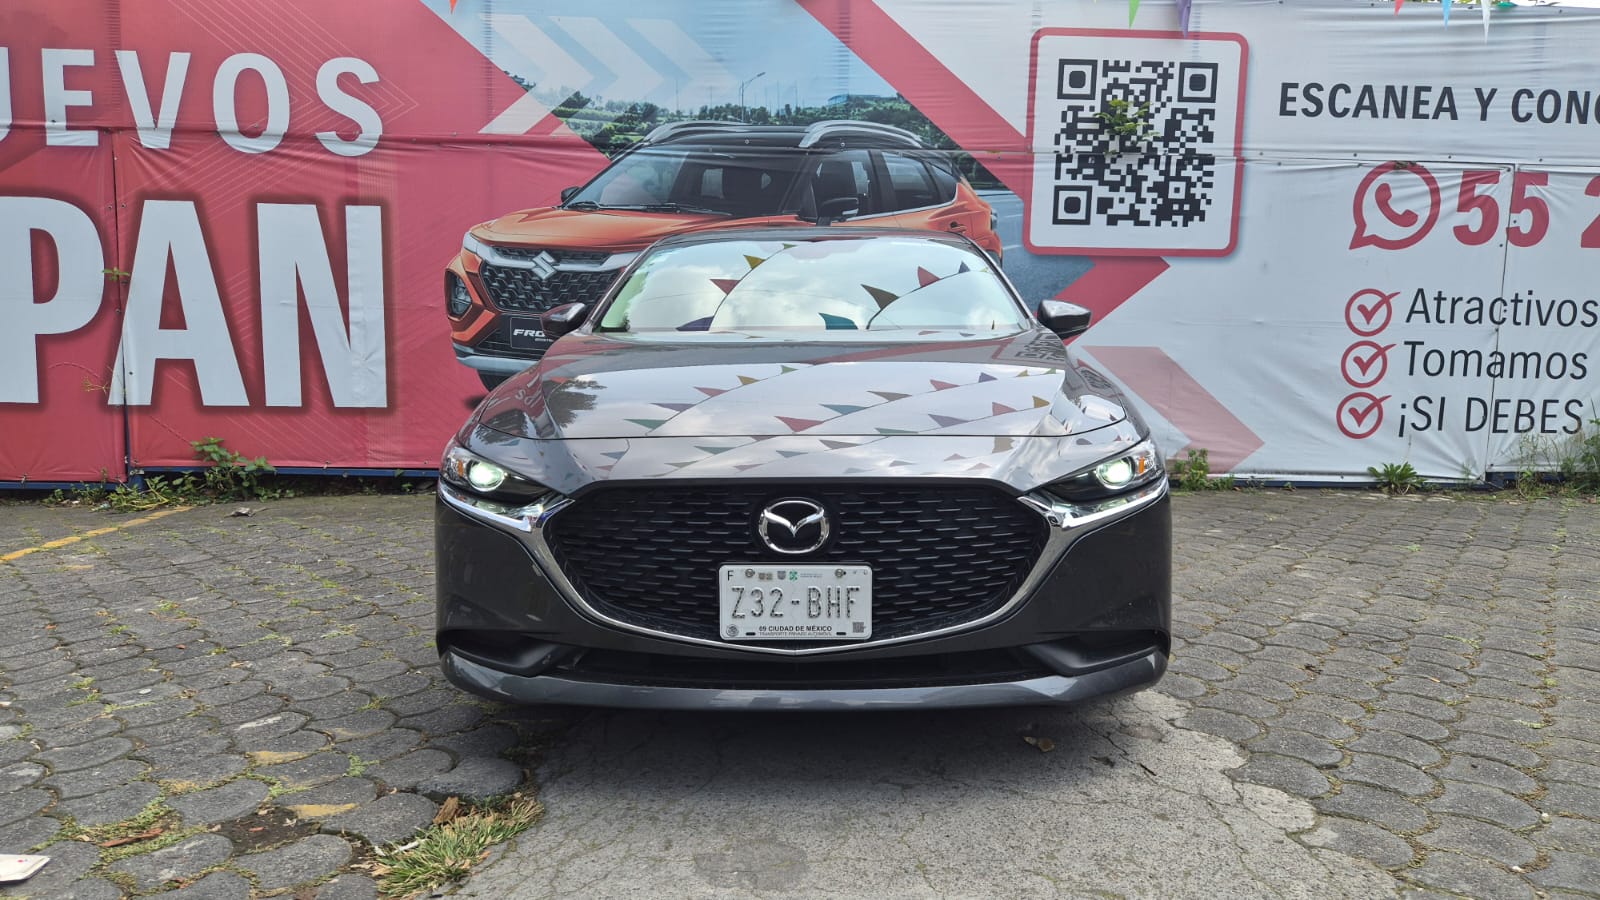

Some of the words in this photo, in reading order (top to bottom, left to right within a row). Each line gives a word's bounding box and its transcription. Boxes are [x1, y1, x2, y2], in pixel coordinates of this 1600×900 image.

[0, 47, 383, 157] EVOS
[1278, 81, 1459, 121] ESCANEA
[1474, 87, 1498, 121] Y
[1511, 88, 1600, 125] CON
[1452, 170, 1550, 248] 55
[0, 196, 388, 408] PAN
[1405, 287, 1599, 328] Atractivos
[1403, 340, 1588, 380] Tomamos
[1398, 395, 1446, 438] ¡SI
[1464, 396, 1584, 435] DEBES
[731, 587, 861, 619] Z32-BHF
[806, 624, 833, 632] MÉXICO
